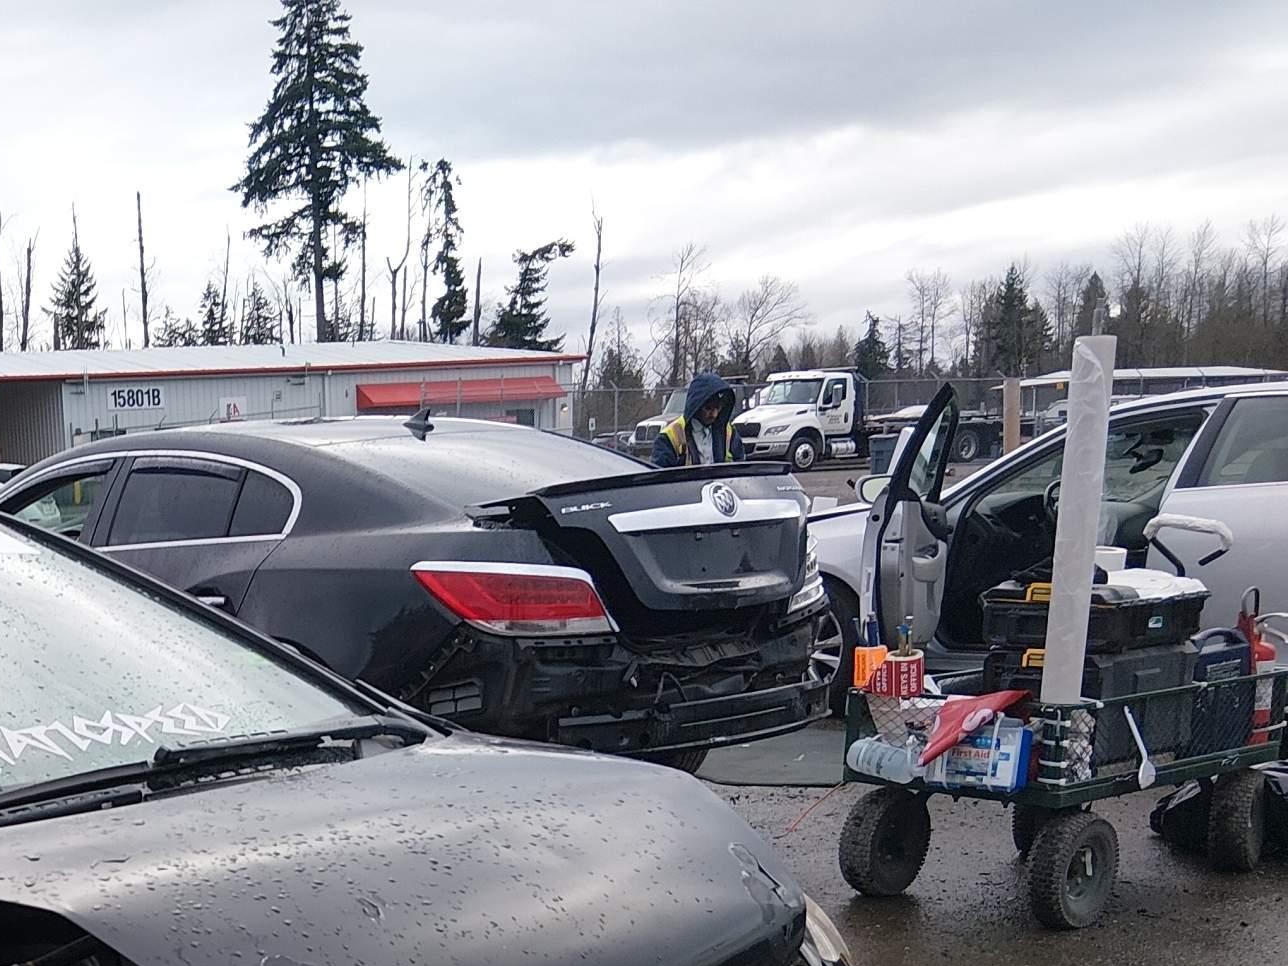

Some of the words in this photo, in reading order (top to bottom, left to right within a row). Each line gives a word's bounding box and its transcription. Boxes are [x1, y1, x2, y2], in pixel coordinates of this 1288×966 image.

[110, 388, 161, 408] 15801B
[560, 501, 613, 514] BUICK
[900, 662, 909, 672] IN
[900, 672, 909, 695] KEYS
[910, 663, 918, 693] OFFICE
[952, 748, 972, 758] First
[974, 750, 991, 759] Aid
